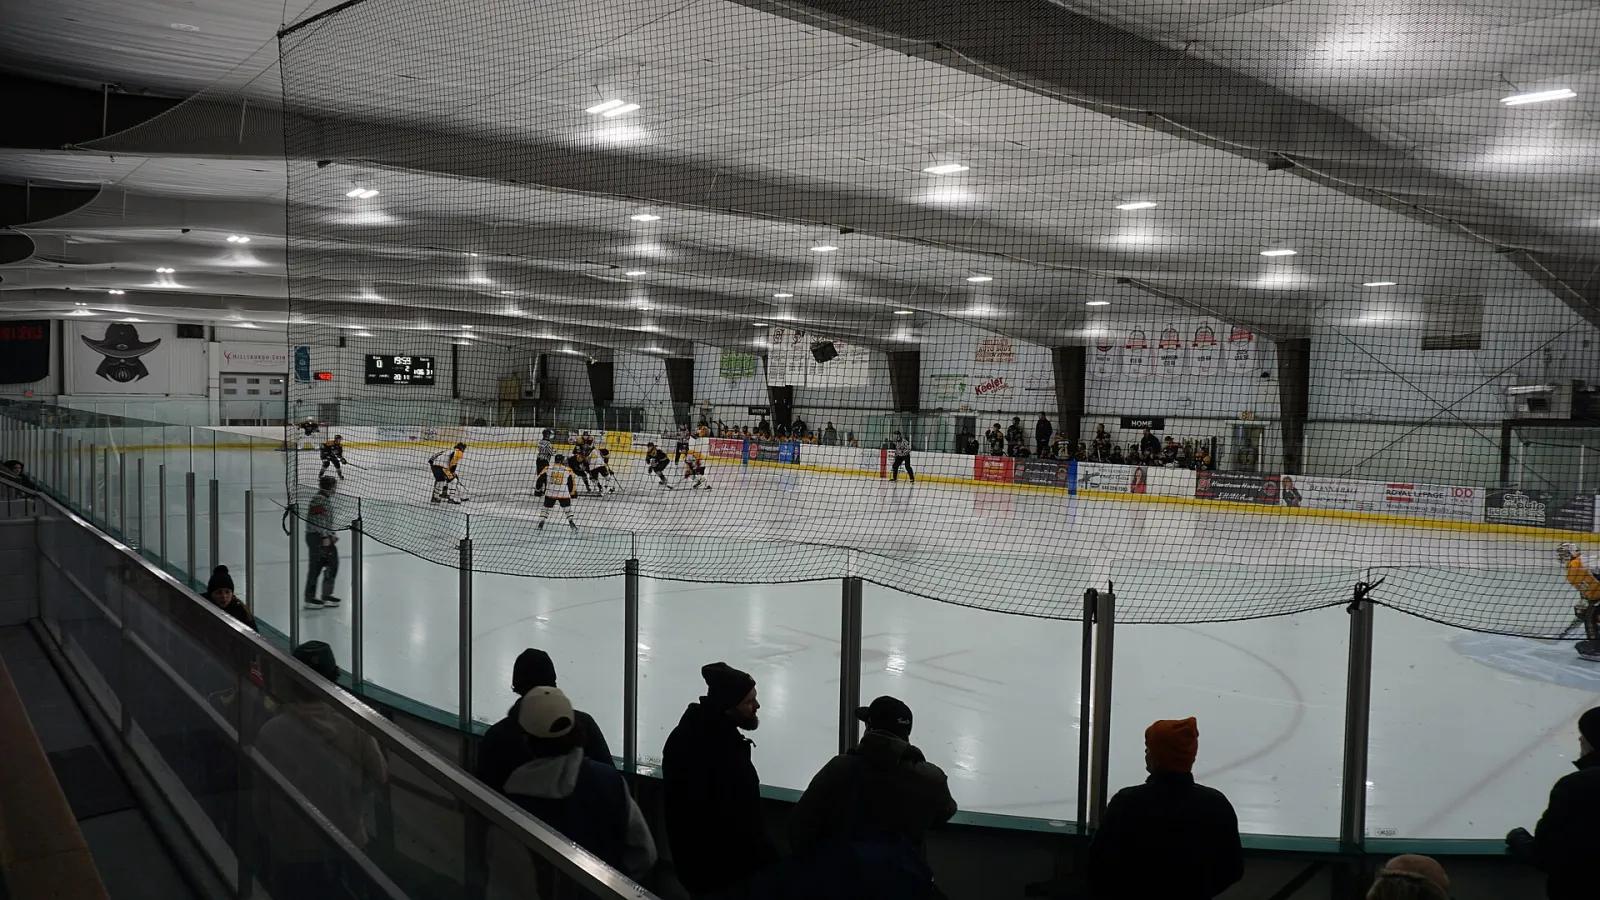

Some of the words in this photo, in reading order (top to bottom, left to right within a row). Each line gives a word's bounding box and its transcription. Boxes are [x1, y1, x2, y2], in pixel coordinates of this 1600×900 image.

[377, 360, 383, 368] 0
[974, 376, 1004, 396] Keeler
[1131, 420, 1153, 428] HOME
[551, 471, 564, 485] 19
[1386, 489, 1412, 497] ROYAL
[1451, 487, 1473, 498] 100
